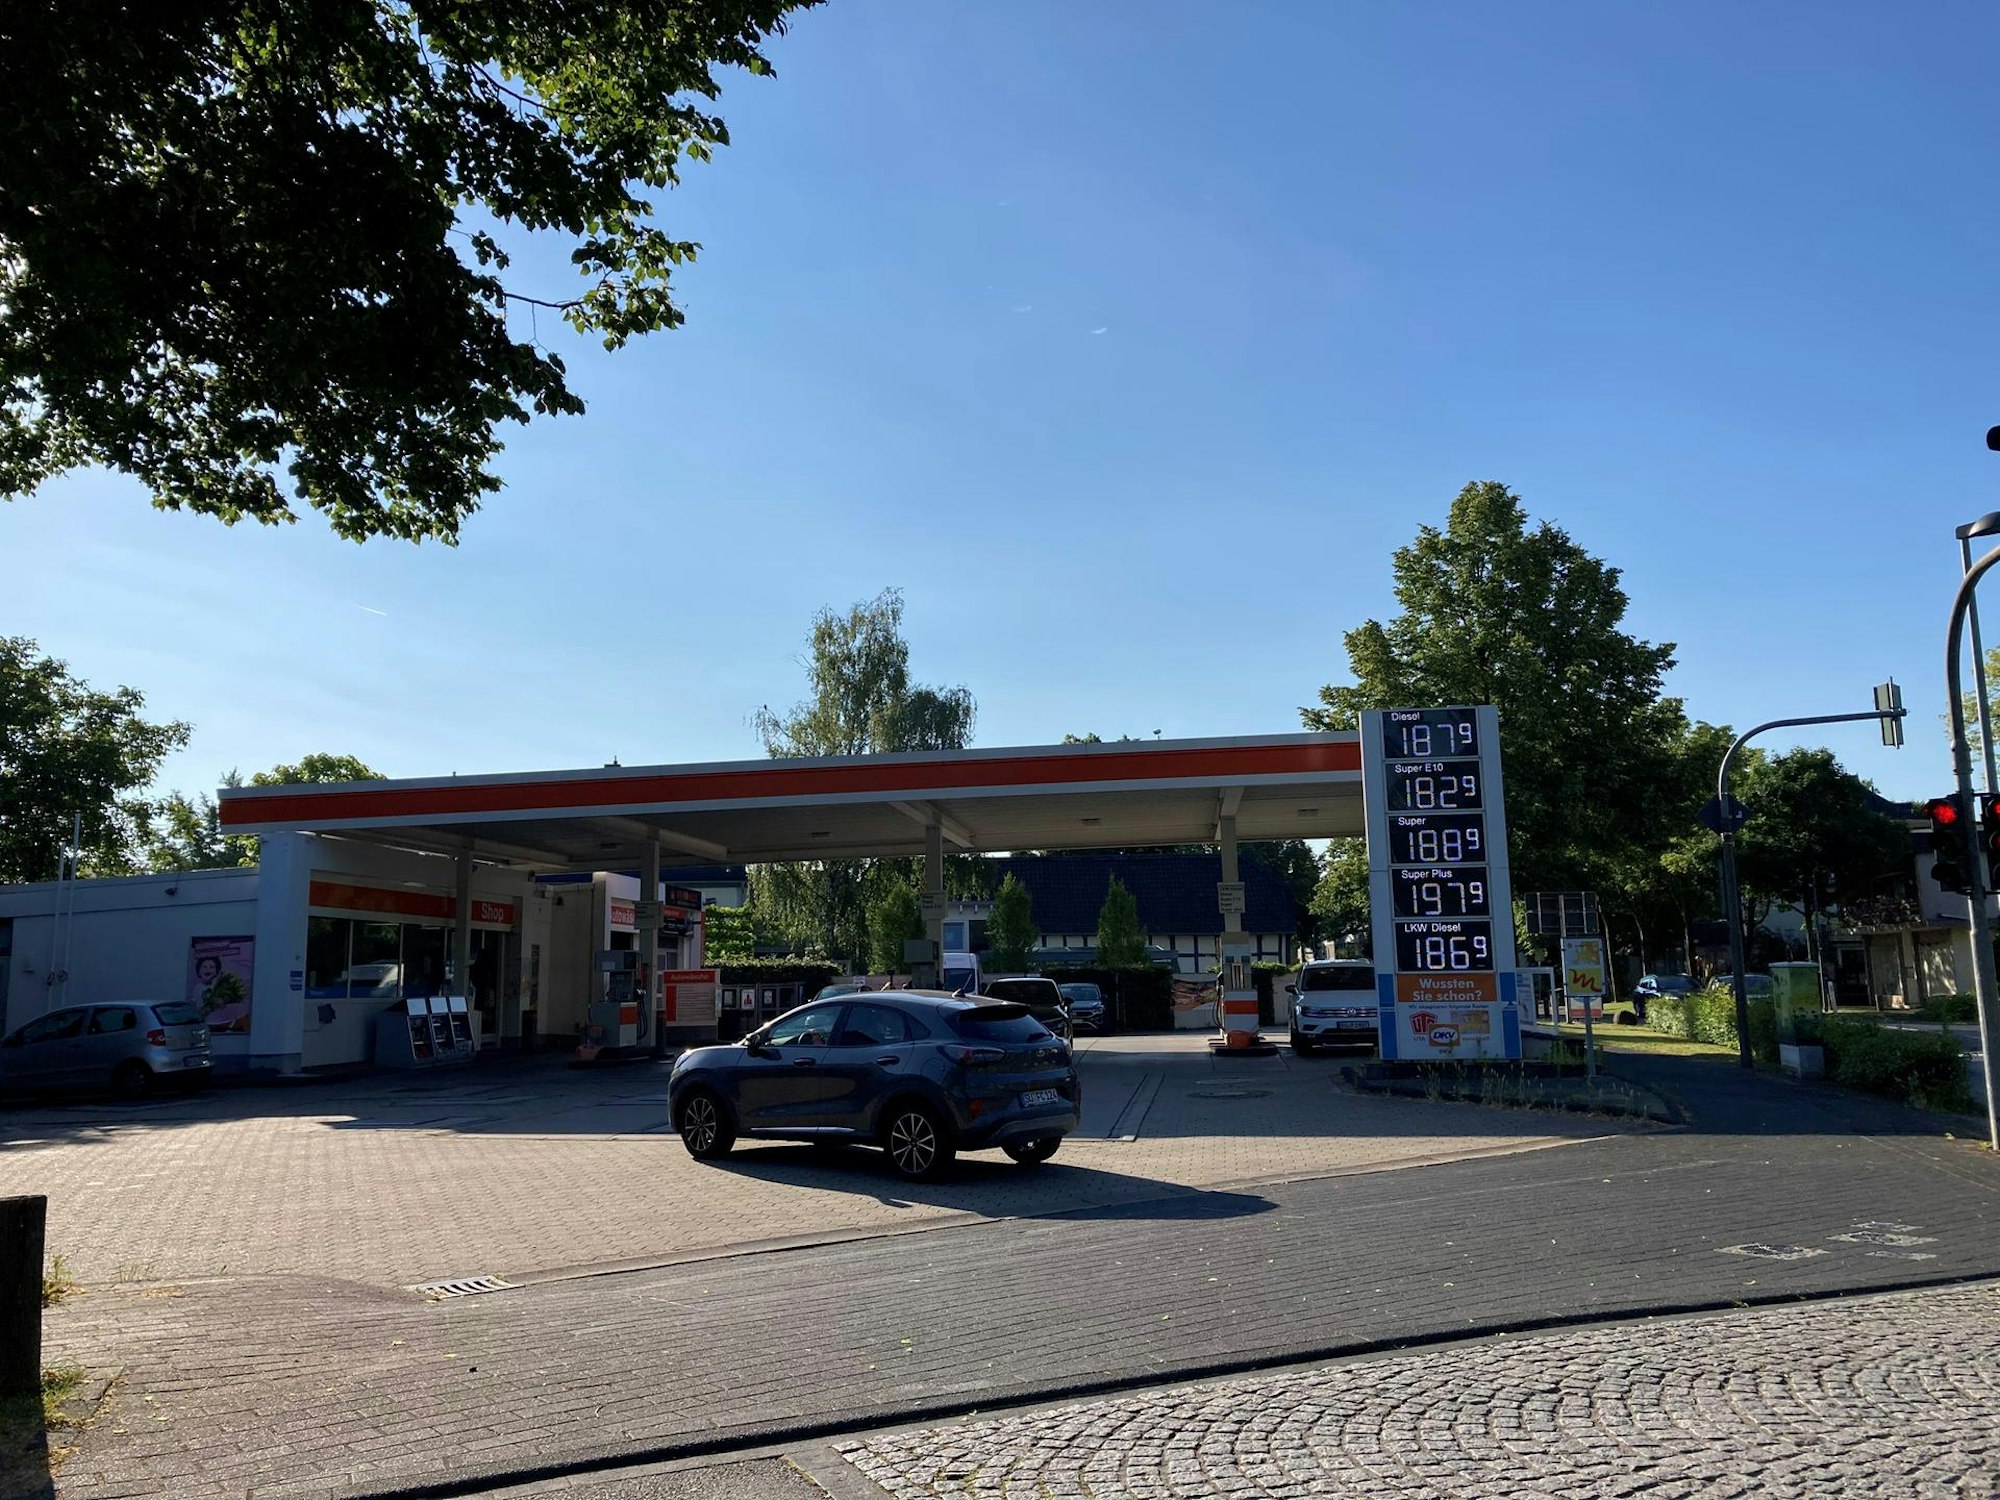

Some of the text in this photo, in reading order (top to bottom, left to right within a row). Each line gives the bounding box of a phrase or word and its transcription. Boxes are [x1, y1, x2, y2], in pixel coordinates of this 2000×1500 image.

[1391, 712, 1420, 721] Diesel
[1402, 722, 1473, 756] 1879
[1395, 763, 1444, 774] Super E10
[1405, 775, 1476, 809] 1829
[1398, 816, 1426, 826] Super
[1408, 828, 1480, 862] 1889
[1401, 869, 1453, 879] Super Plus
[1411, 881, 1484, 915] 1979
[481, 902, 504, 923] Shop
[1404, 923, 1462, 932] LKW Diesel
[1415, 935, 1488, 969] 1869
[1419, 978, 1475, 989] Wussten
[1412, 990, 1483, 1001] Sie schon?
[1433, 1031, 1456, 1039] DKV
